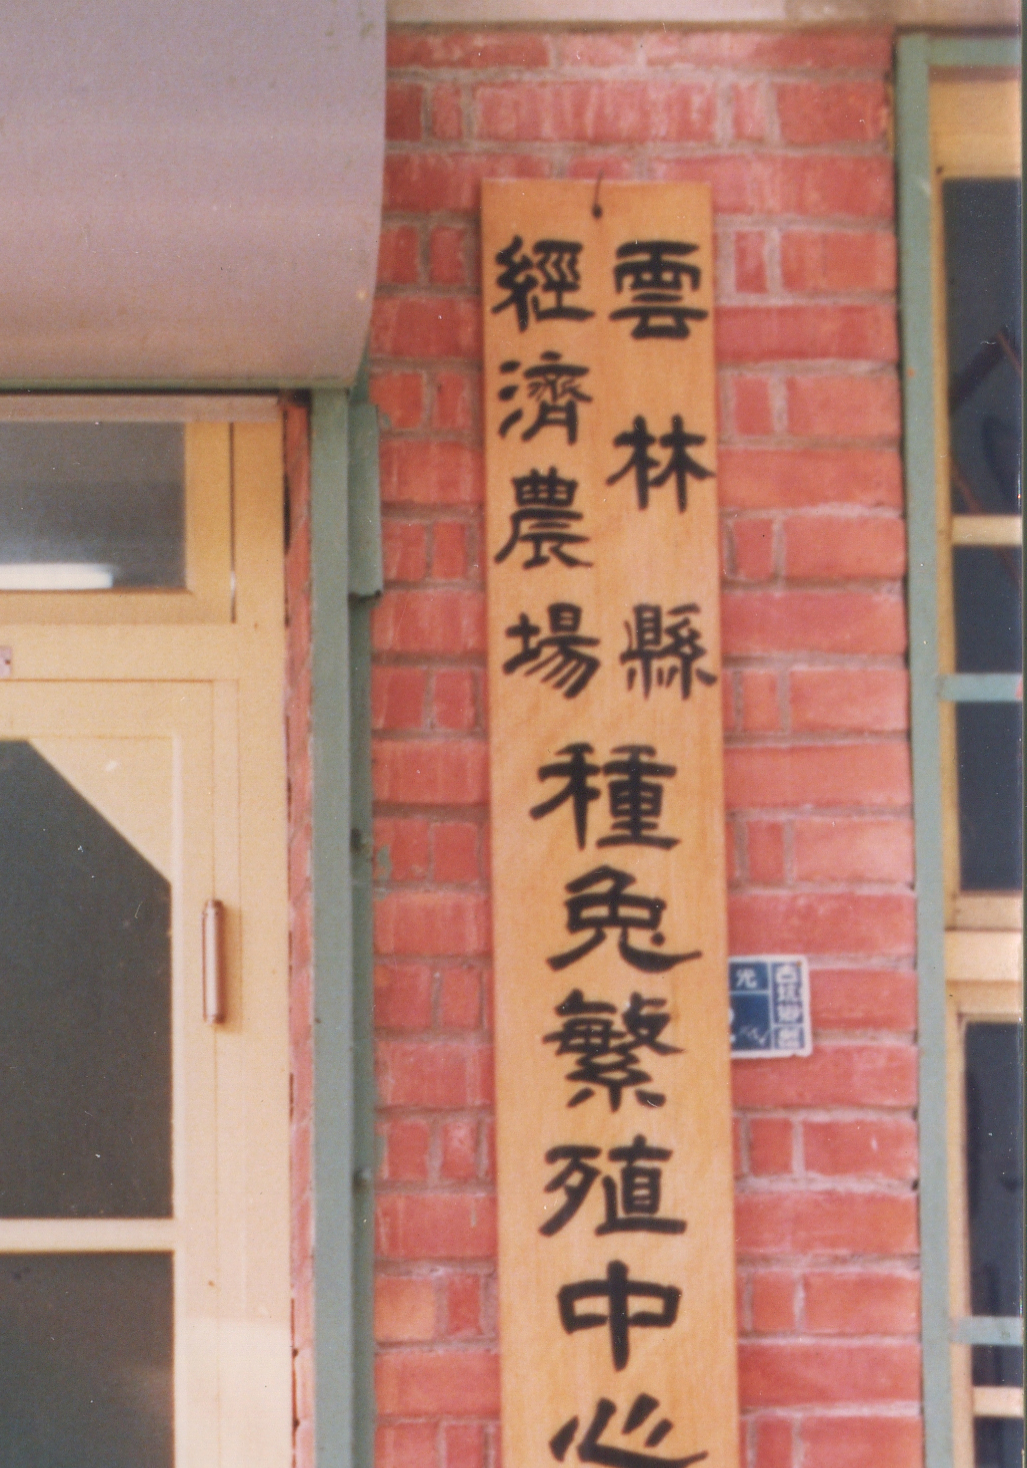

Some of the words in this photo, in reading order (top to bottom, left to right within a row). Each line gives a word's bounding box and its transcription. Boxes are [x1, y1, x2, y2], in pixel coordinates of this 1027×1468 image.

[491, 236, 601, 698] 經濟農場
[607, 240, 717, 699] 雲林縣
